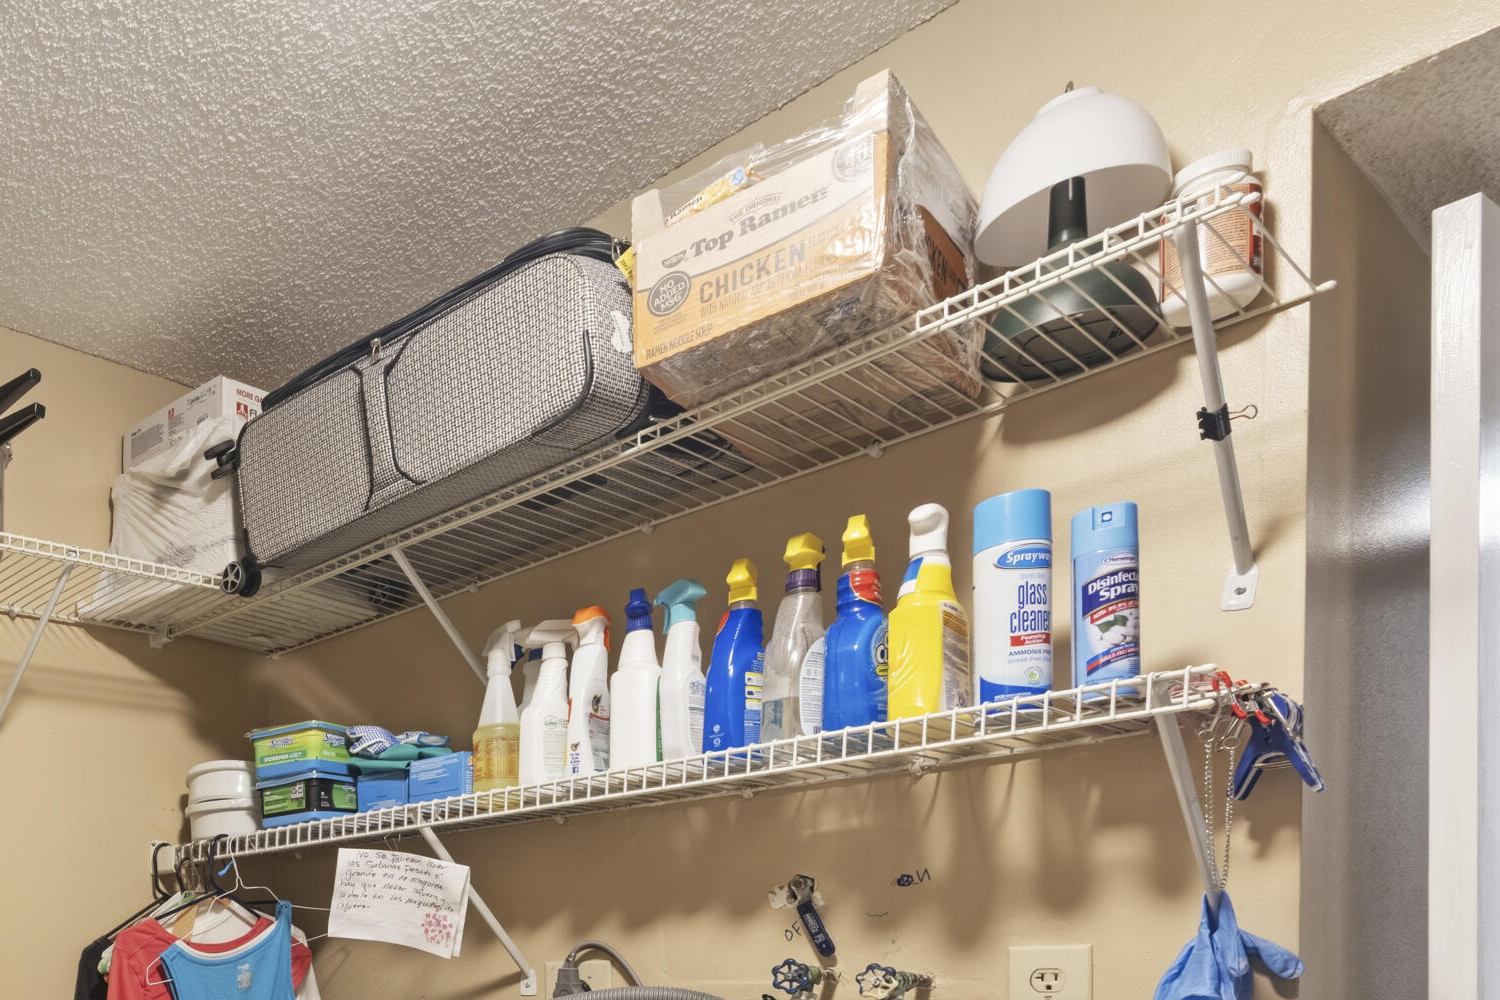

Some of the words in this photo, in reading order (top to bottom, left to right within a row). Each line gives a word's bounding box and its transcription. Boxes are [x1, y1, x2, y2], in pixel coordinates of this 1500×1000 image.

[690, 226, 734, 258] Top
[739, 187, 828, 237] Ramen
[699, 240, 806, 303] CHICKEN
[653, 282, 685, 308] ADDED
[660, 279, 675, 295] NO
[660, 294, 682, 312] MSG
[236, 388, 253, 401] MORE
[1017, 581, 1047, 609] glass
[1008, 649, 1042, 657] AMMONIA
[361, 881, 377, 892] que
